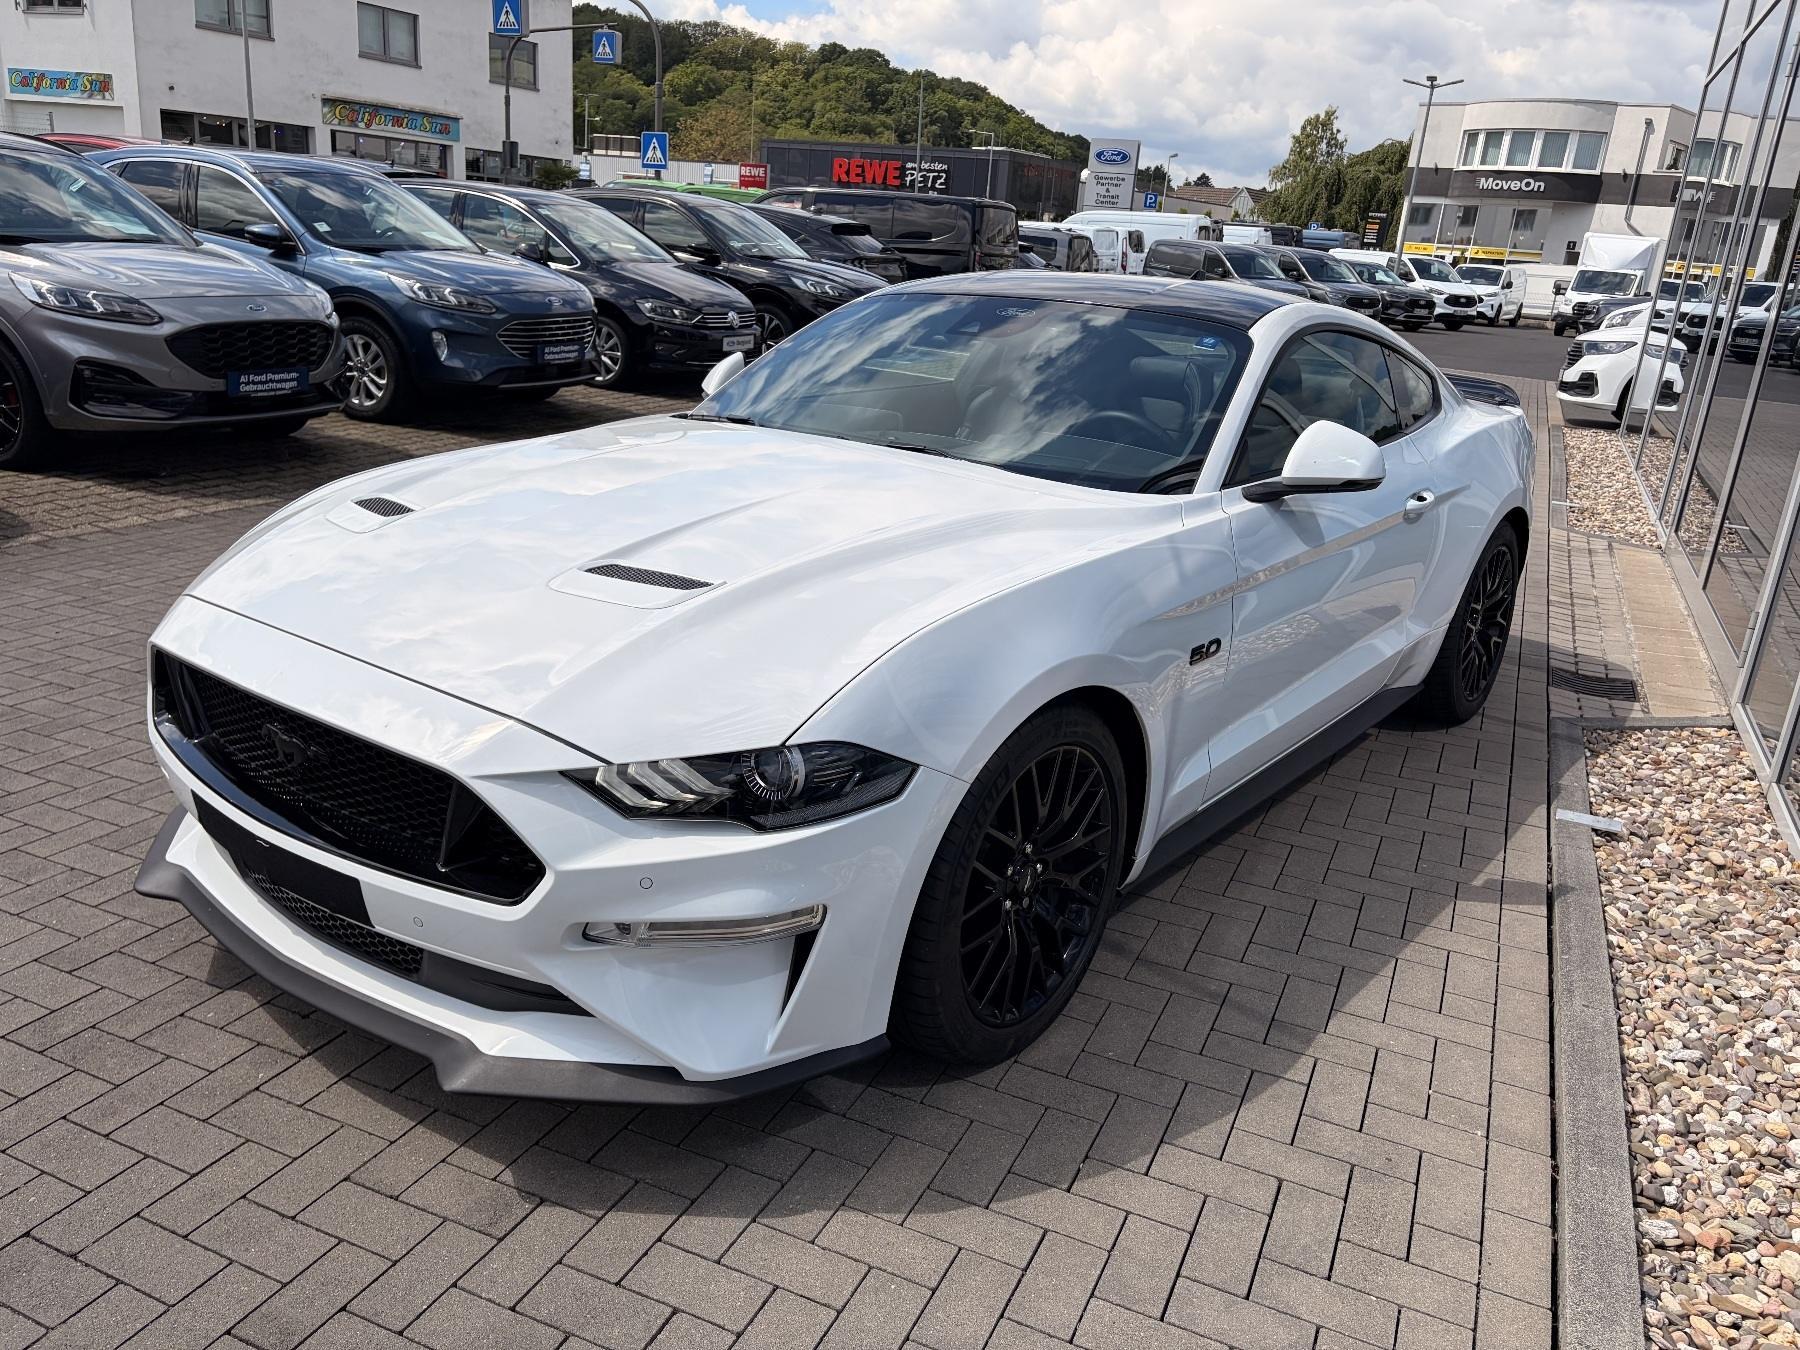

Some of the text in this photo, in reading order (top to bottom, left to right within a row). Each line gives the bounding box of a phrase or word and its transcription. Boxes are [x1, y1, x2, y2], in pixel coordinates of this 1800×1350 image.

[11, 71, 110, 92] California Sun
[335, 104, 451, 135] California Sun
[741, 166, 766, 177] REWE
[832, 157, 902, 186] REWE
[905, 160, 948, 171] am besten
[904, 170, 947, 189] PETZ
[1094, 174, 1126, 182] Gewerbe
[1479, 177, 1545, 192] MoveOn
[1146, 194, 1155, 207] P
[249, 373, 266, 382] Ford
[240, 381, 297, 392] Gebrauchtwagen
[1189, 637, 1222, 666] 5.0
